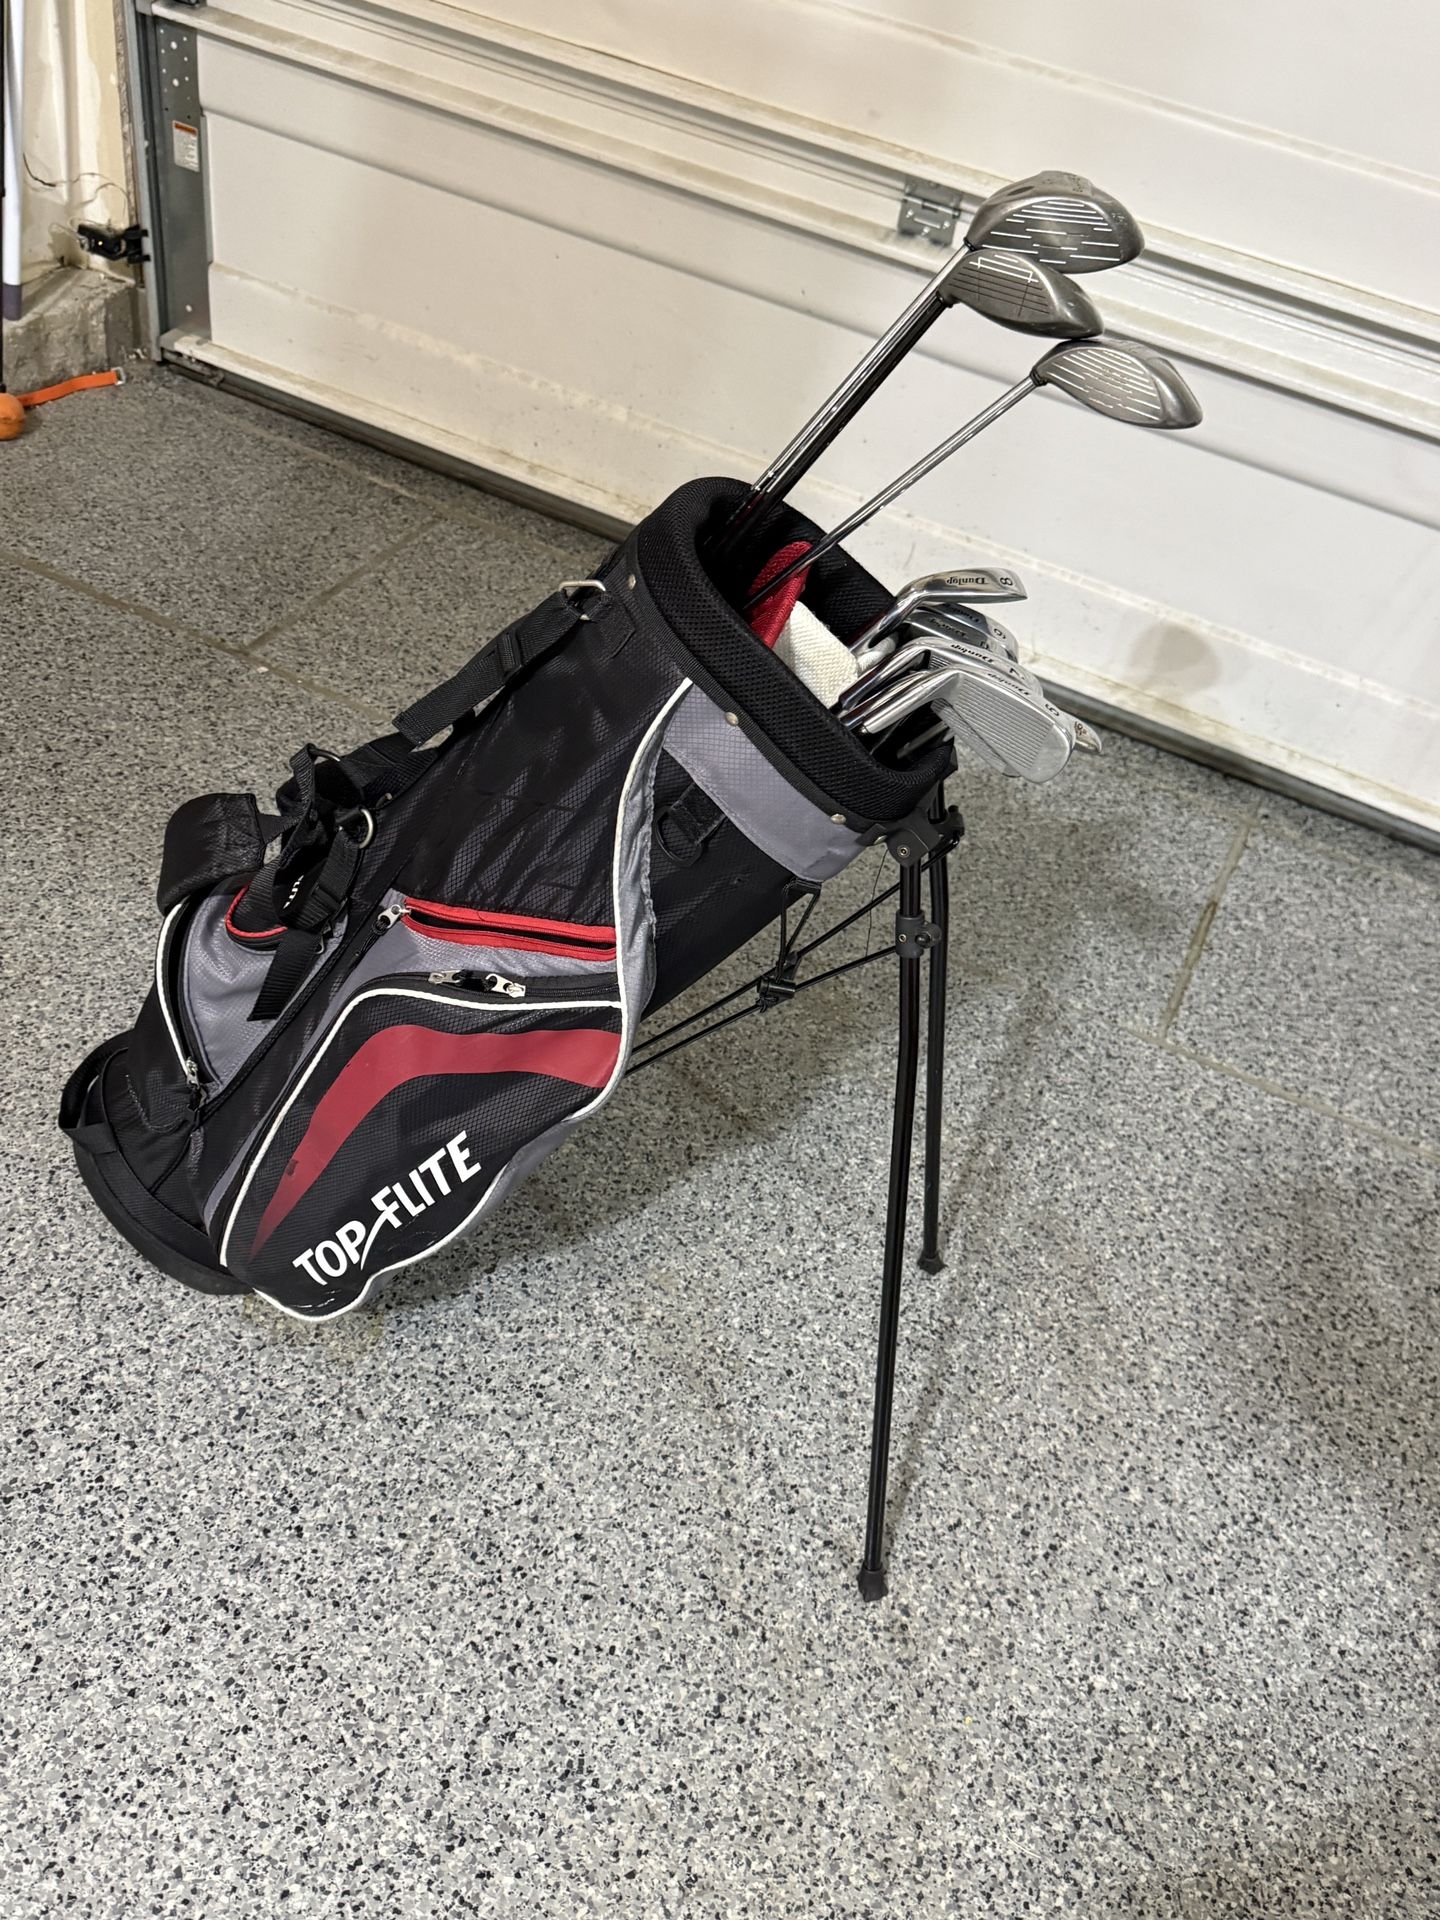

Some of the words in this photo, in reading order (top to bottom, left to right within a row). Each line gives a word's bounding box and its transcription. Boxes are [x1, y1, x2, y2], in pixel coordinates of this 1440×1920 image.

[945, 576, 989, 586] Dunlop
[999, 577, 1014, 587] 8
[951, 643, 995, 664] Dunlop
[292, 1220, 367, 1286] TOP
[361, 1130, 482, 1270] FLITE
